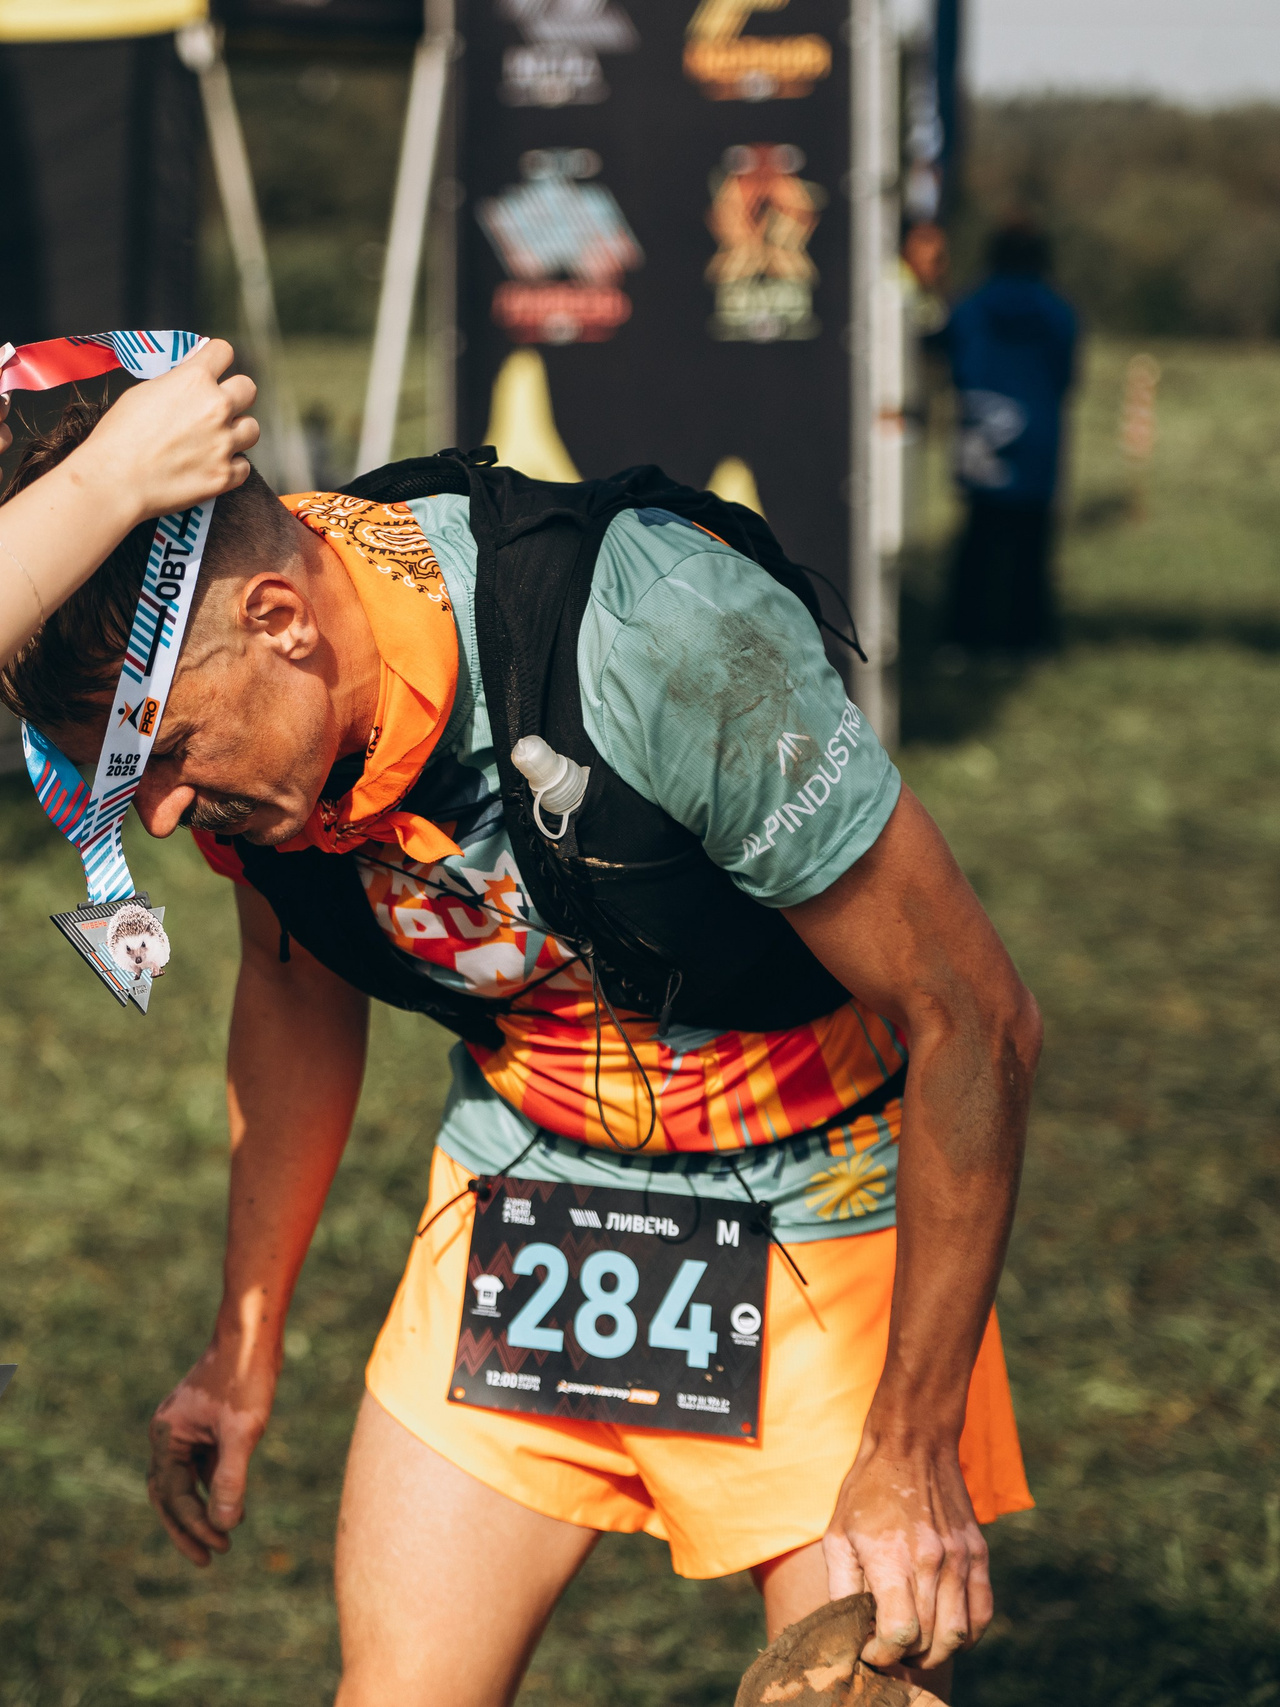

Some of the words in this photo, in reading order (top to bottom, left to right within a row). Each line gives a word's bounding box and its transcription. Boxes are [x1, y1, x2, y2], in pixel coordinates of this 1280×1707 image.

[140, 700, 158, 735] PRO
[109, 753, 141, 766] 14.09
[106, 765, 137, 778] 2025
[605, 1211, 680, 1237] ЛИВЕНЬ
[507, 1241, 718, 1369] 284
[485, 1369, 518, 1389] 12:00
